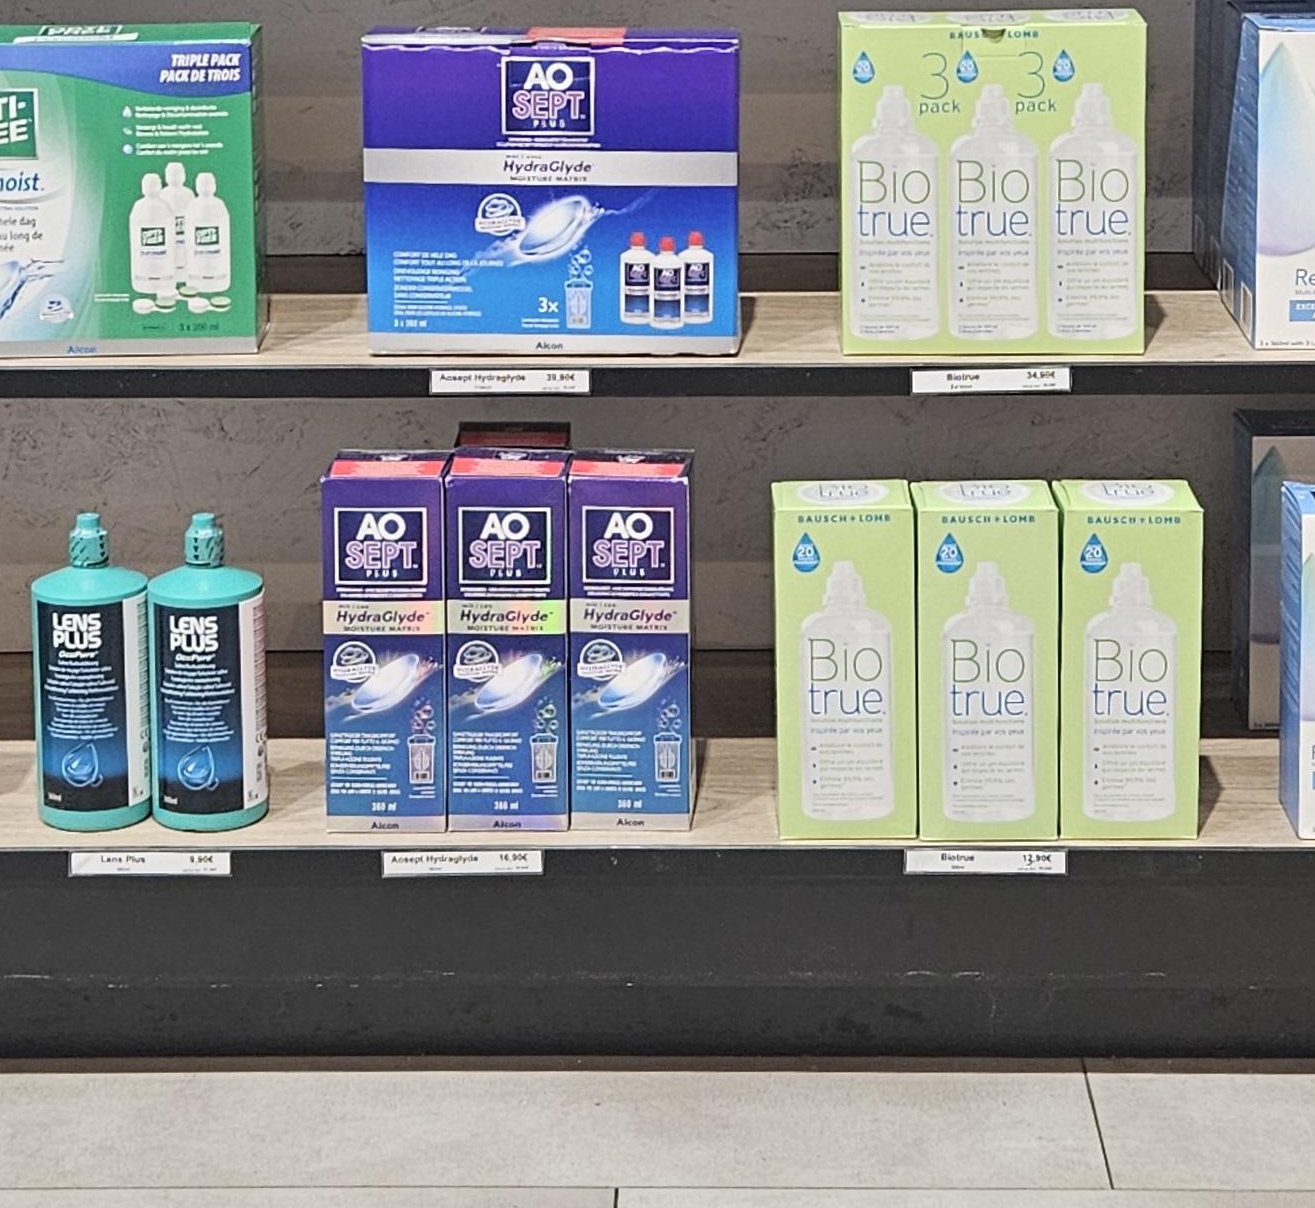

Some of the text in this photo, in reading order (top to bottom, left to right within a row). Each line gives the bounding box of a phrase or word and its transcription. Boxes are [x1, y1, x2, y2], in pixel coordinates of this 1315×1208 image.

[523, 63, 573, 90] AO
[513, 92, 585, 120] SEPT
[503, 160, 591, 174] HydraGlyde
[957, 160, 1029, 204] Bio
[956, 204, 1029, 237] true
[356, 513, 406, 539] AO
[859, 515, 891, 523] LOMB
[345, 541, 418, 569] SEPT
[52, 612, 101, 632] LENS
[336, 610, 425, 625] HydraGlyde
[52, 630, 102, 650] PLUS
[809, 639, 882, 682] Bio
[809, 683, 882, 715] true
